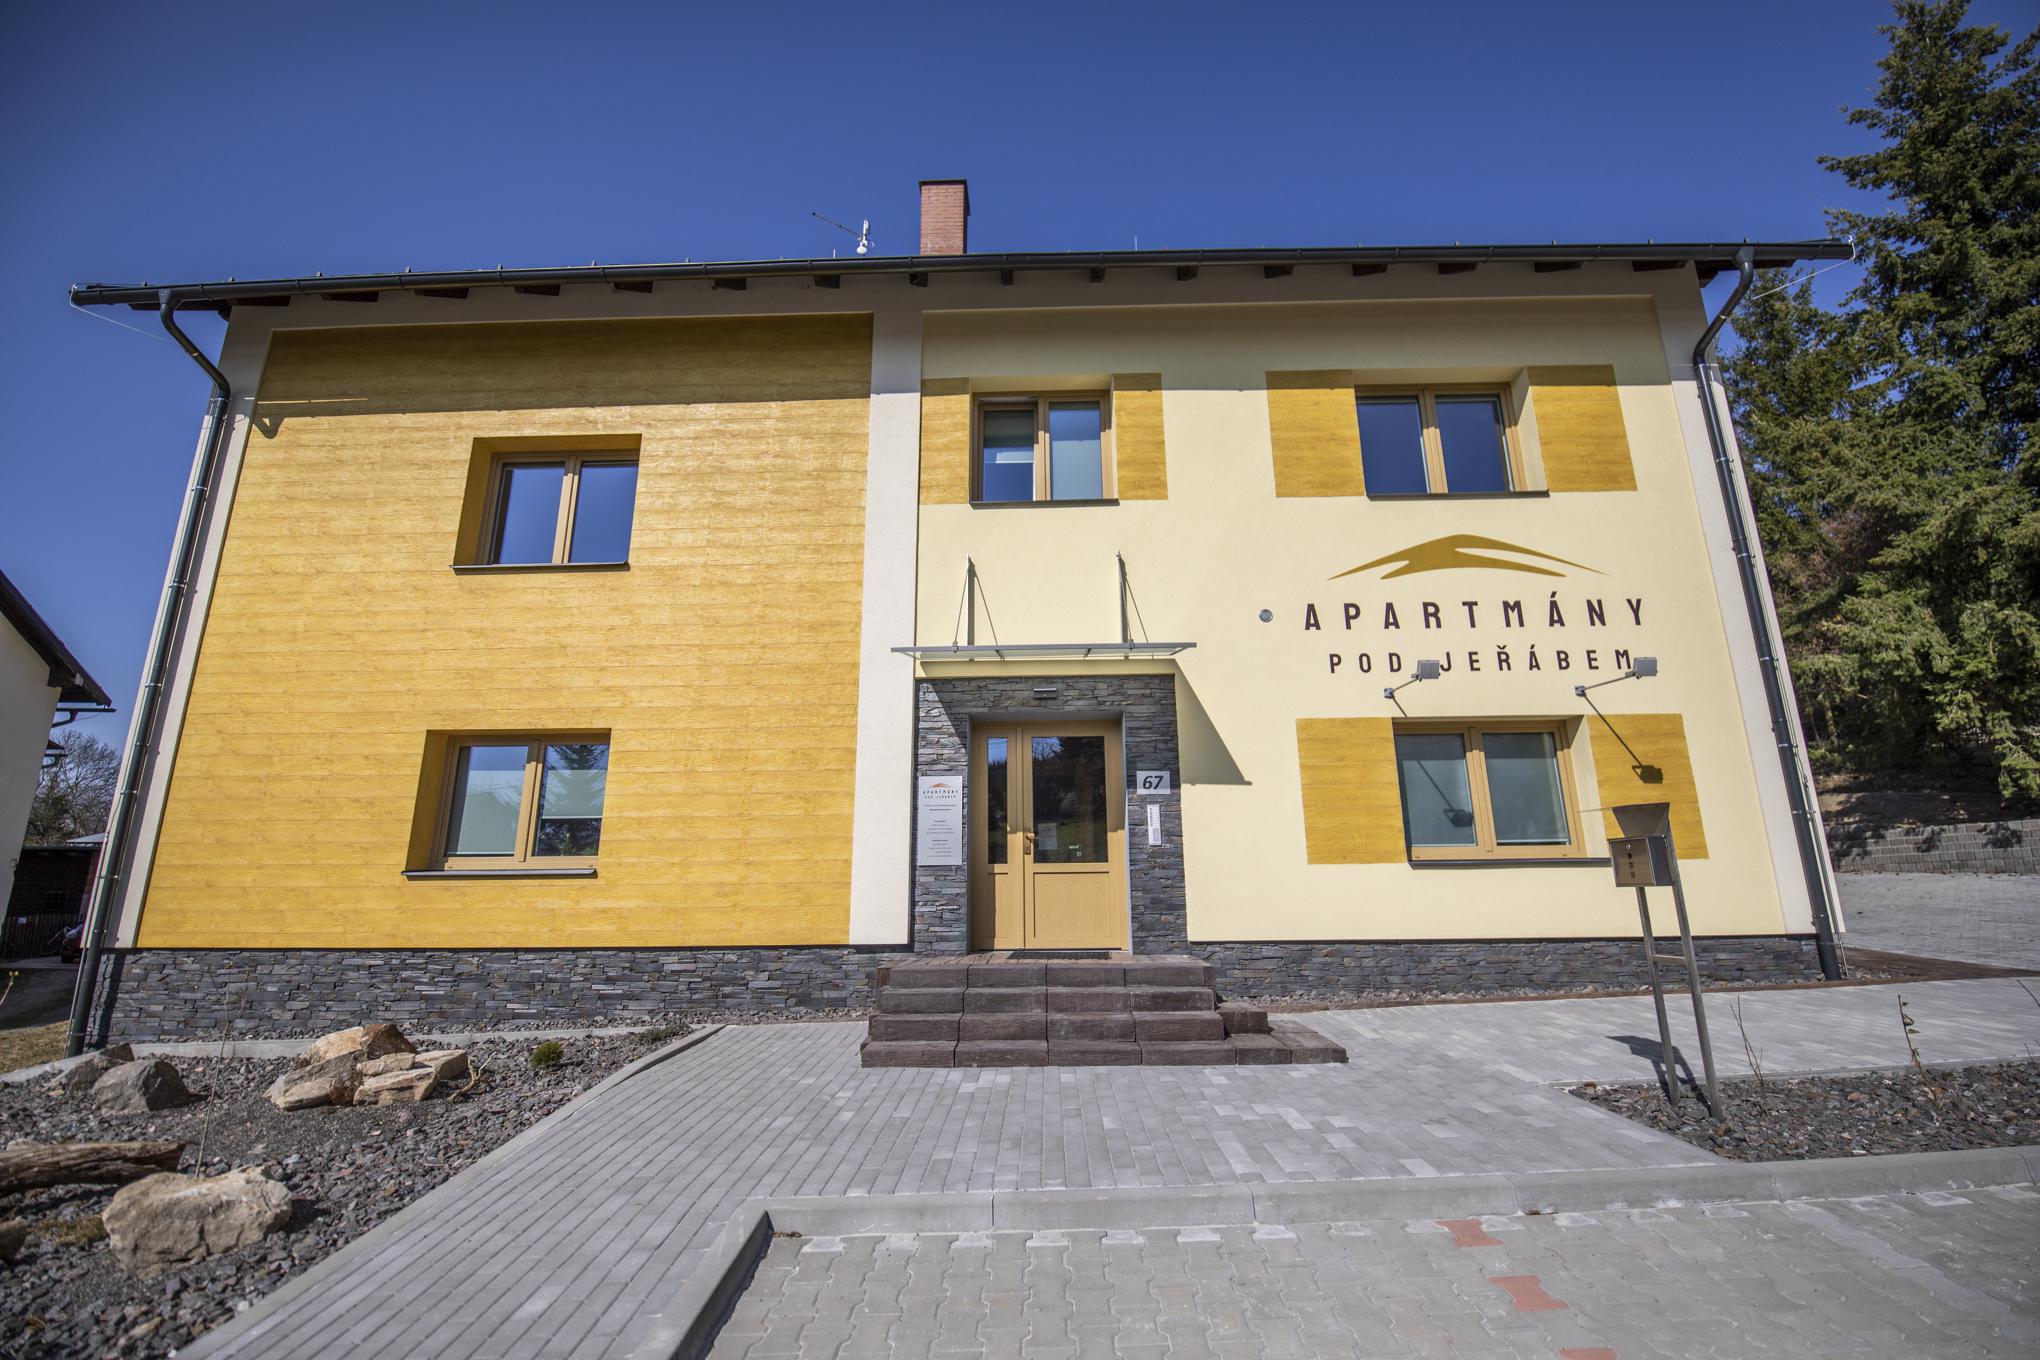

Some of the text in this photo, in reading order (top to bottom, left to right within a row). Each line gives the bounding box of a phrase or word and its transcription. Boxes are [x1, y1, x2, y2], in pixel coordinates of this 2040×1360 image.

[1304, 591, 1642, 630] APARTMÁNY
[1329, 644, 1632, 674] POD JEŘÁBEM
[1142, 775, 1164, 790] 67
